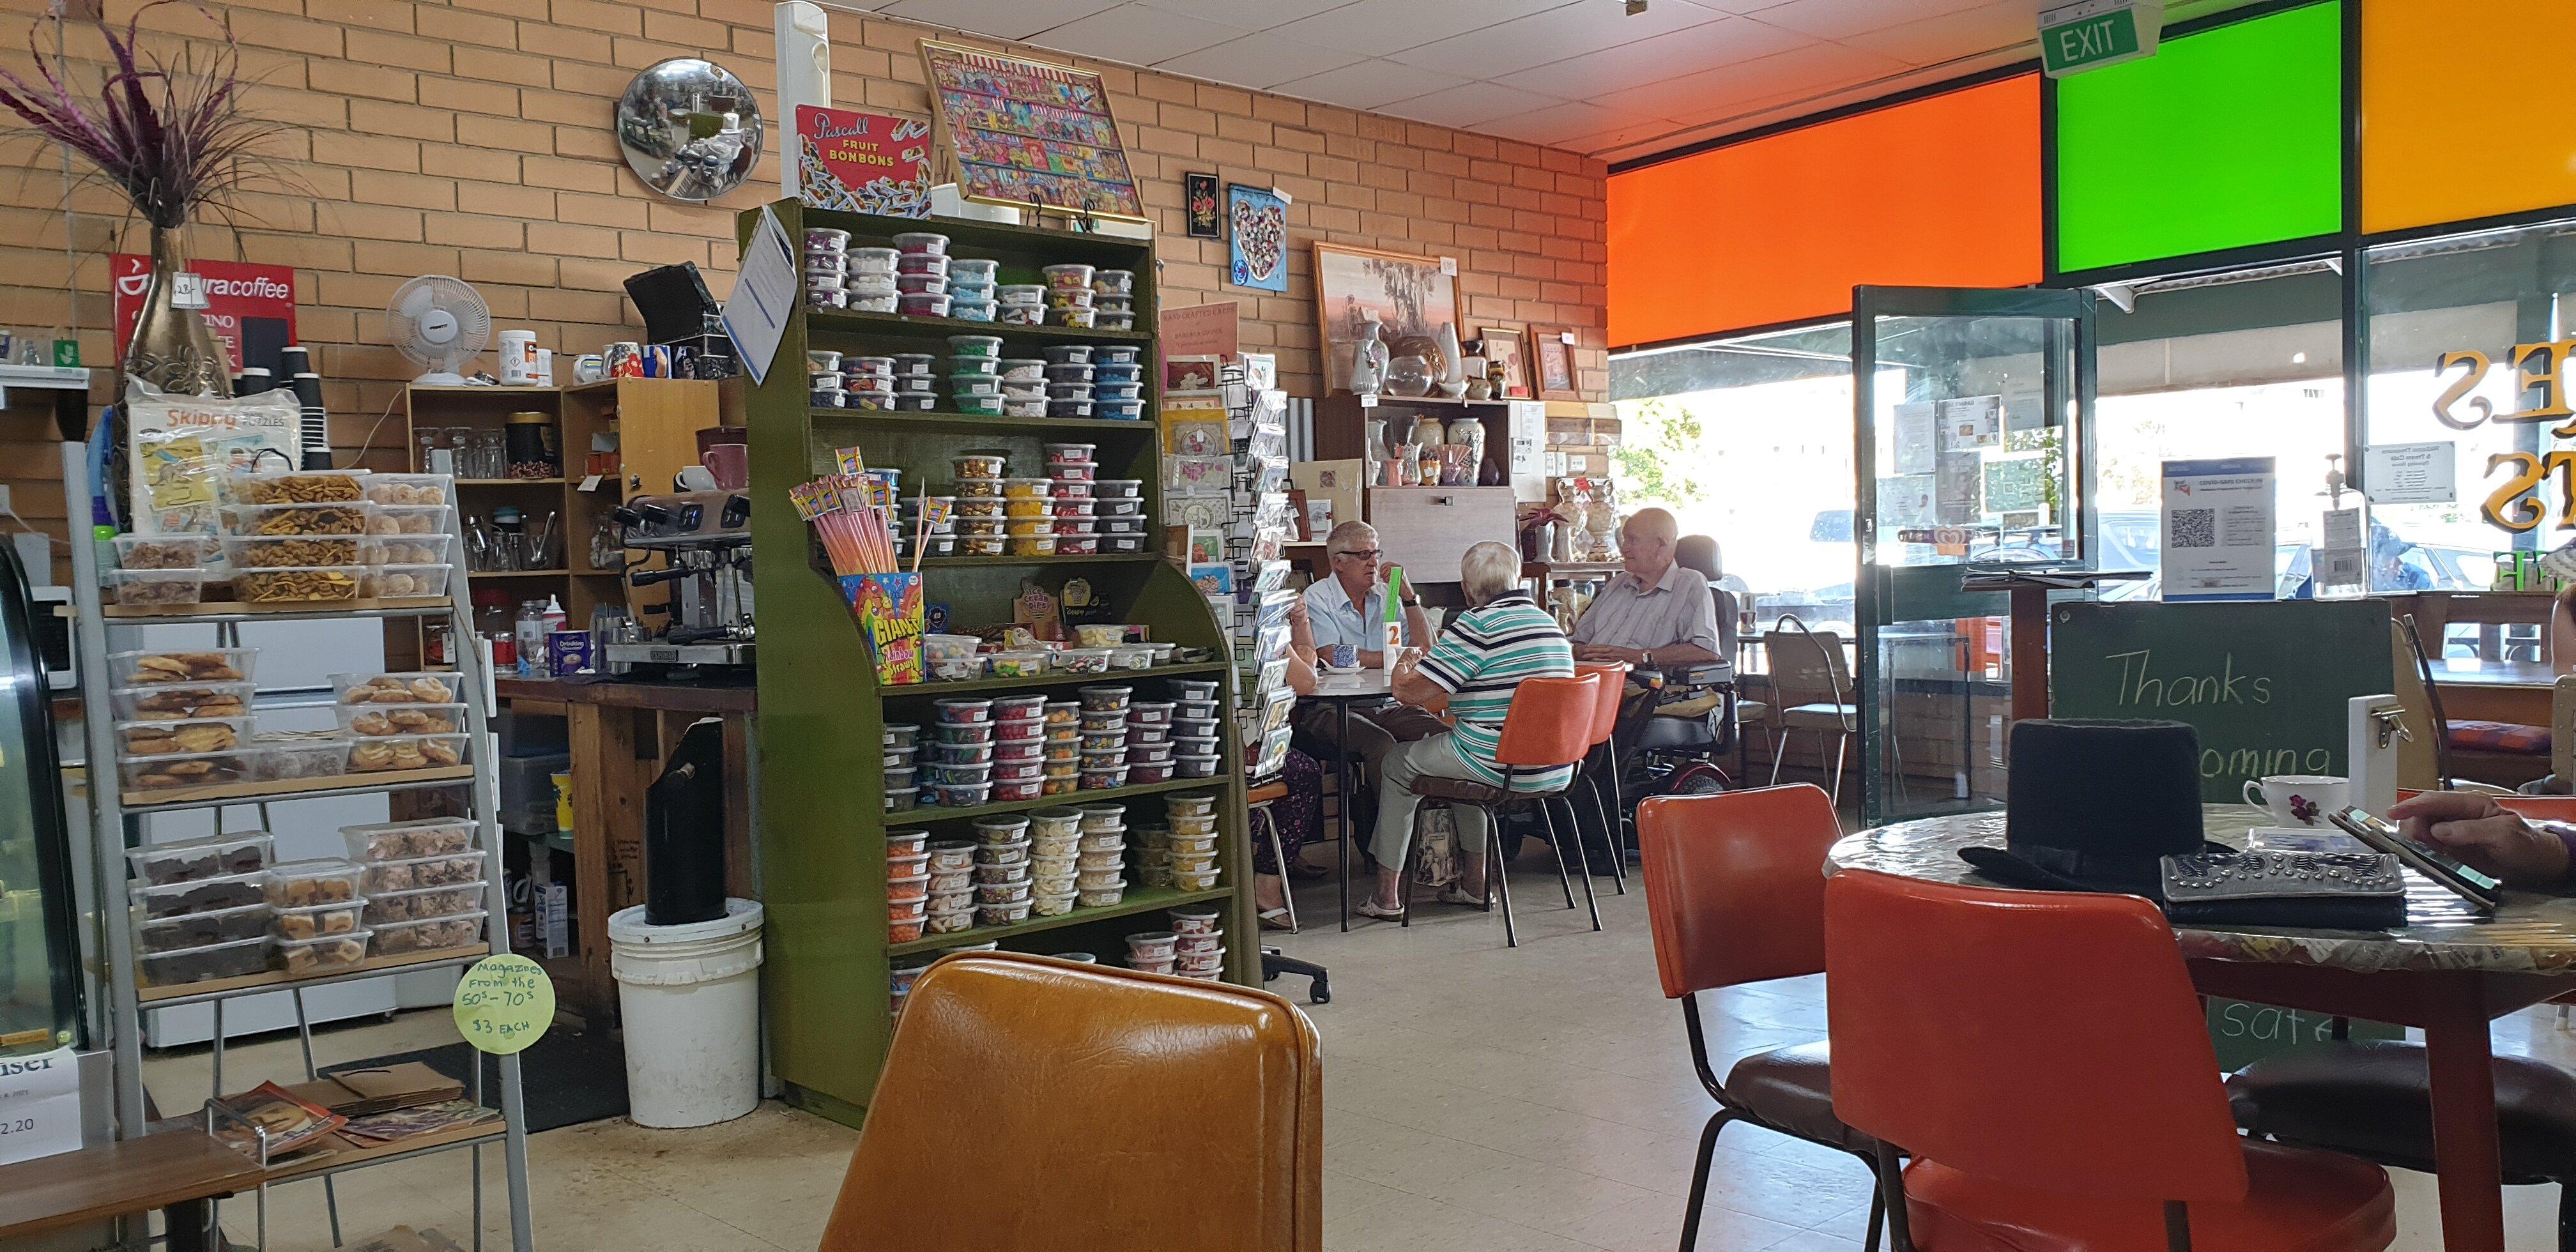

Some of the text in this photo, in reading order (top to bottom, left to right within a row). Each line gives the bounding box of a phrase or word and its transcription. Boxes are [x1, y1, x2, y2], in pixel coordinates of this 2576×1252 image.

[2060, 19, 2114, 62] EXIT
[813, 113, 869, 139] Pascall
[842, 139, 879, 152] FRUIT
[829, 149, 894, 167] BONBONS
[874, 618, 922, 646] GIANT
[1389, 626, 1400, 645] 2
[884, 646, 914, 662] Rainbow
[2106, 649, 2271, 706] Thanks
[2200, 748, 2330, 779] oming
[469, 977, 535, 989] From the
[500, 1021, 530, 1034] EACH
